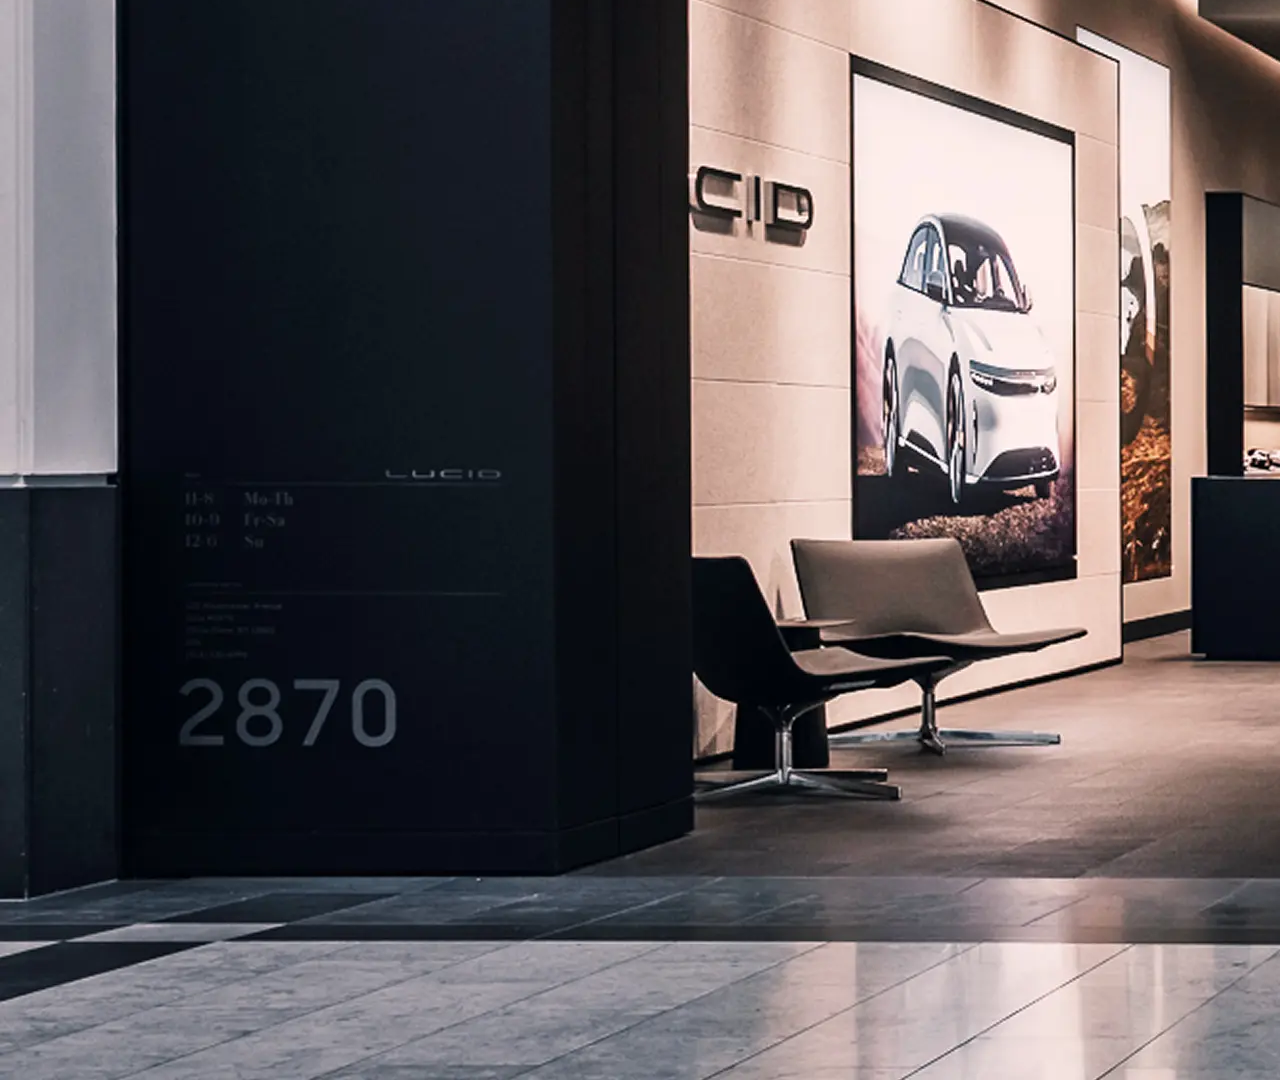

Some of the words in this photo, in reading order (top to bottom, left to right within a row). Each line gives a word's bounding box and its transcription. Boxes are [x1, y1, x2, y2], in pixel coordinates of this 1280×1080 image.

[385, 469, 501, 479] LUCID
[243, 491, 294, 506] Mo-Th
[179, 677, 398, 748] 2870
